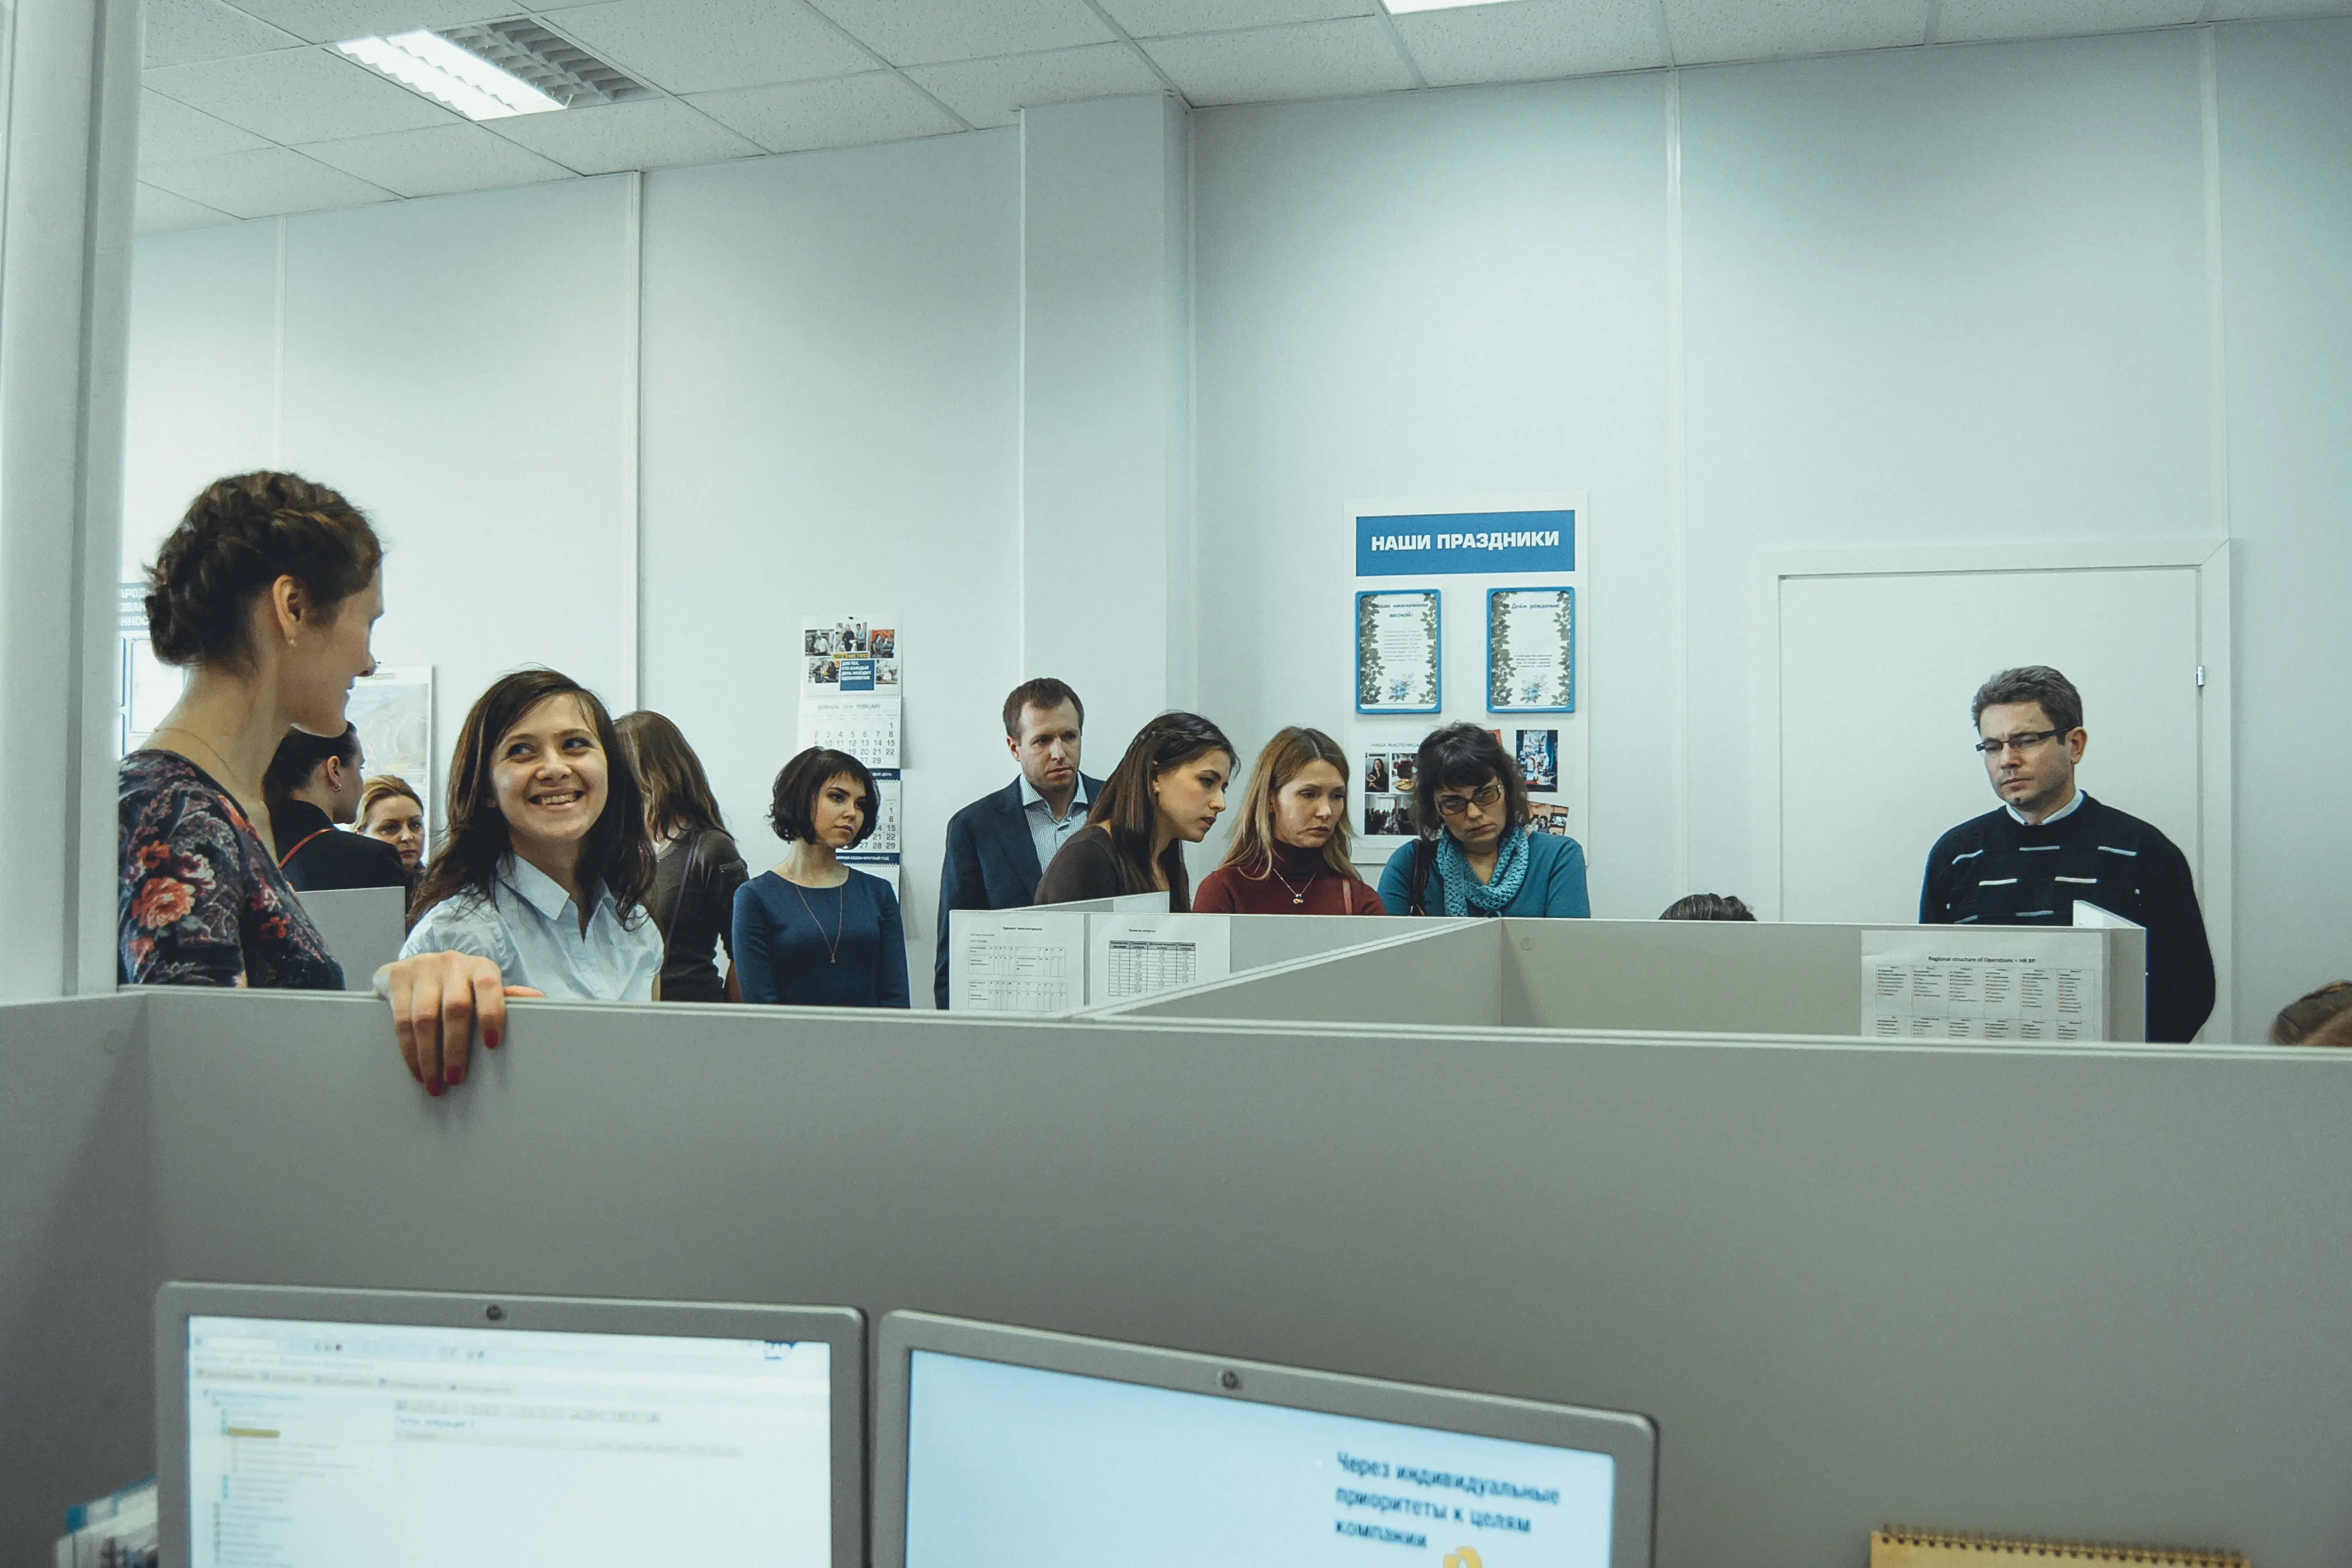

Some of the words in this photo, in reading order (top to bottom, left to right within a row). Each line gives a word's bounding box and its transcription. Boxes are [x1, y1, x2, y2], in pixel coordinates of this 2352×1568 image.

[1371, 534, 1431, 551] НАШИ
[1437, 531, 1559, 550] ПРАЗДНИКИ
[1336, 1451, 1390, 1478] Через
[1396, 1466, 1560, 1505] индивидуальные
[1335, 1487, 1447, 1520] приоритеты
[1453, 1506, 1463, 1521] к
[1470, 1508, 1531, 1533] целям
[1334, 1520, 1427, 1548] компании
